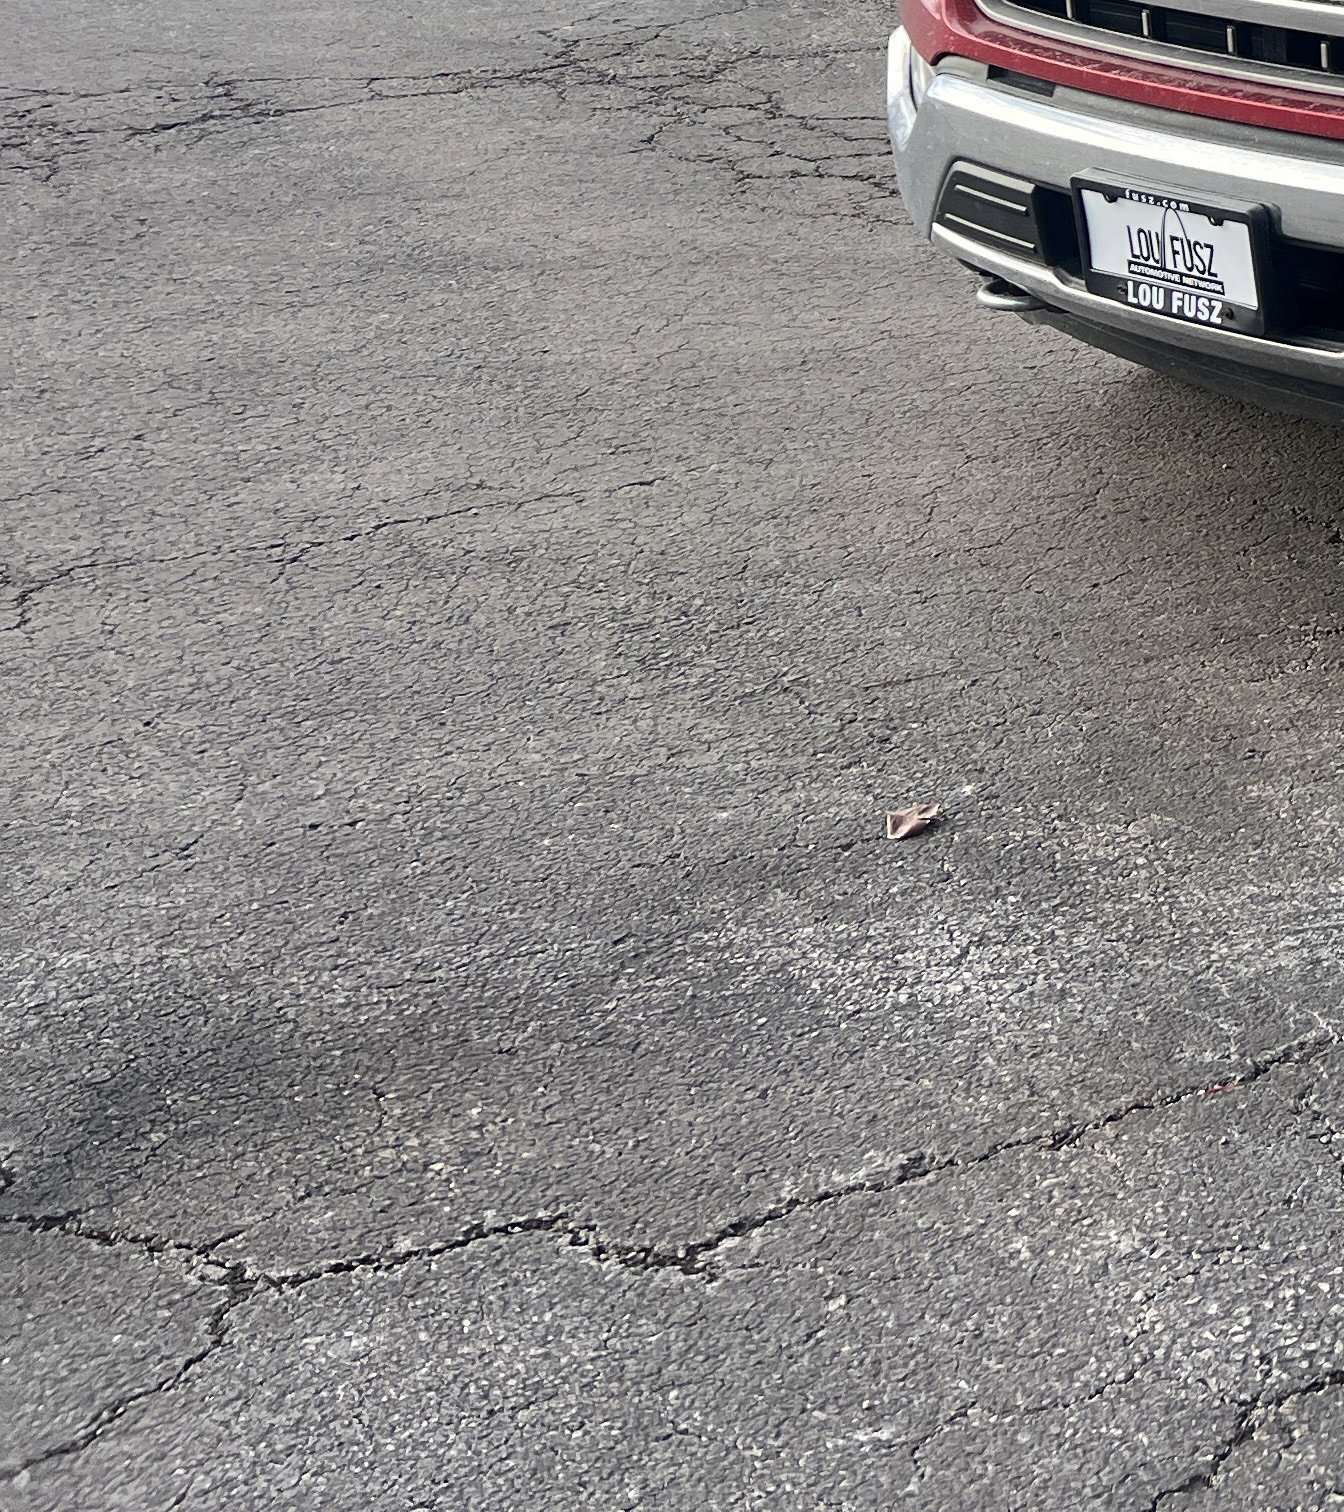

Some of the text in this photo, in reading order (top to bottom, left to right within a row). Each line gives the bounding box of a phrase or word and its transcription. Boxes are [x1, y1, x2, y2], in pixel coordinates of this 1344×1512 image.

[1125, 189, 1190, 212] fusz.com
[1127, 225, 1218, 278] LOU FUSZ
[1129, 263, 1224, 294] AUTOMOTIVE NETWORK
[1127, 280, 1223, 324] LOU FUSZ
